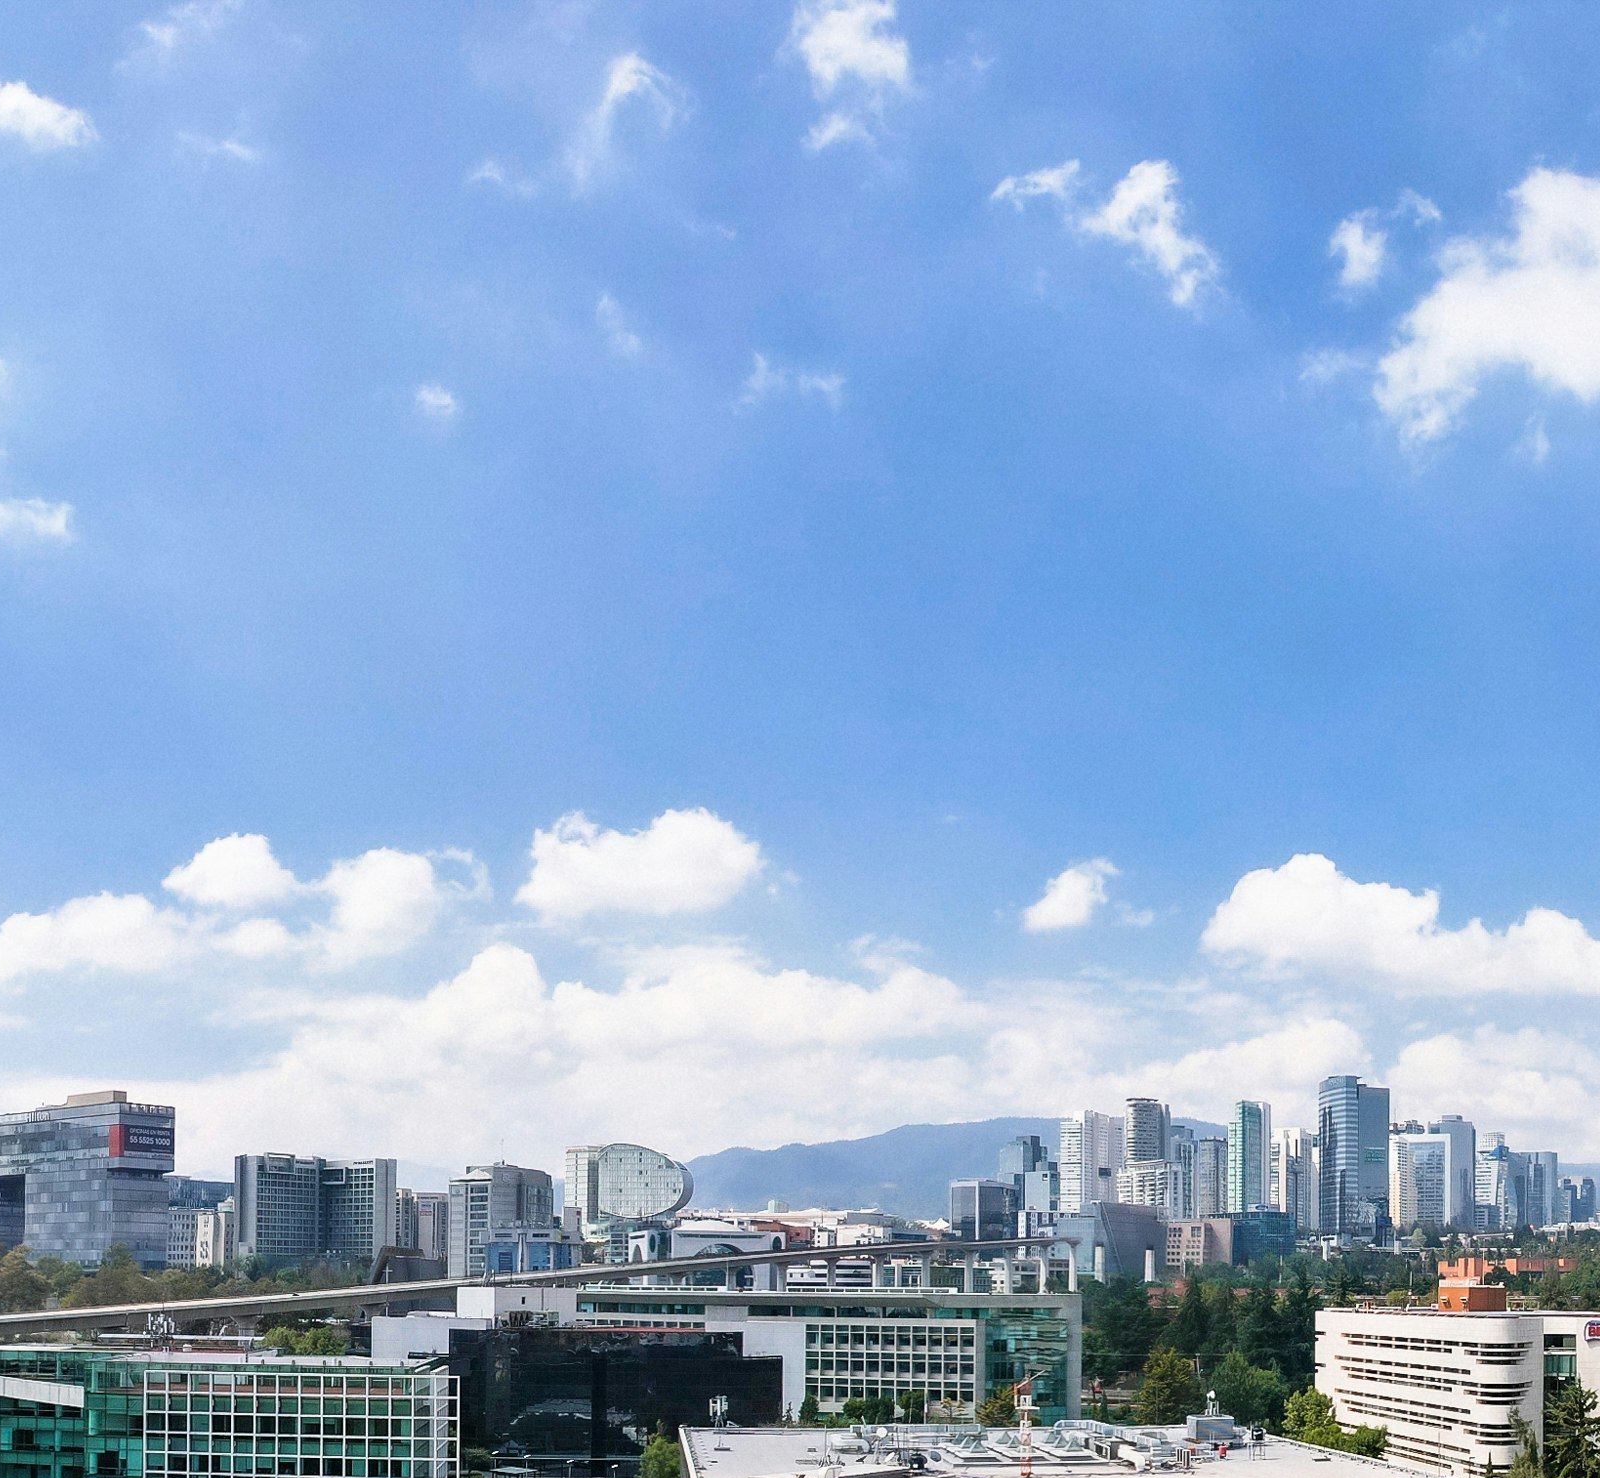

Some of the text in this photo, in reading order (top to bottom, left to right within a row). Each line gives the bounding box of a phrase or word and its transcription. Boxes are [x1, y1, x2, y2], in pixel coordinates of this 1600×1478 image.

[25, 1111, 50, 1123] Hilton
[129, 1136, 138, 1144] 55
[138, 1136, 154, 1145] 5525
